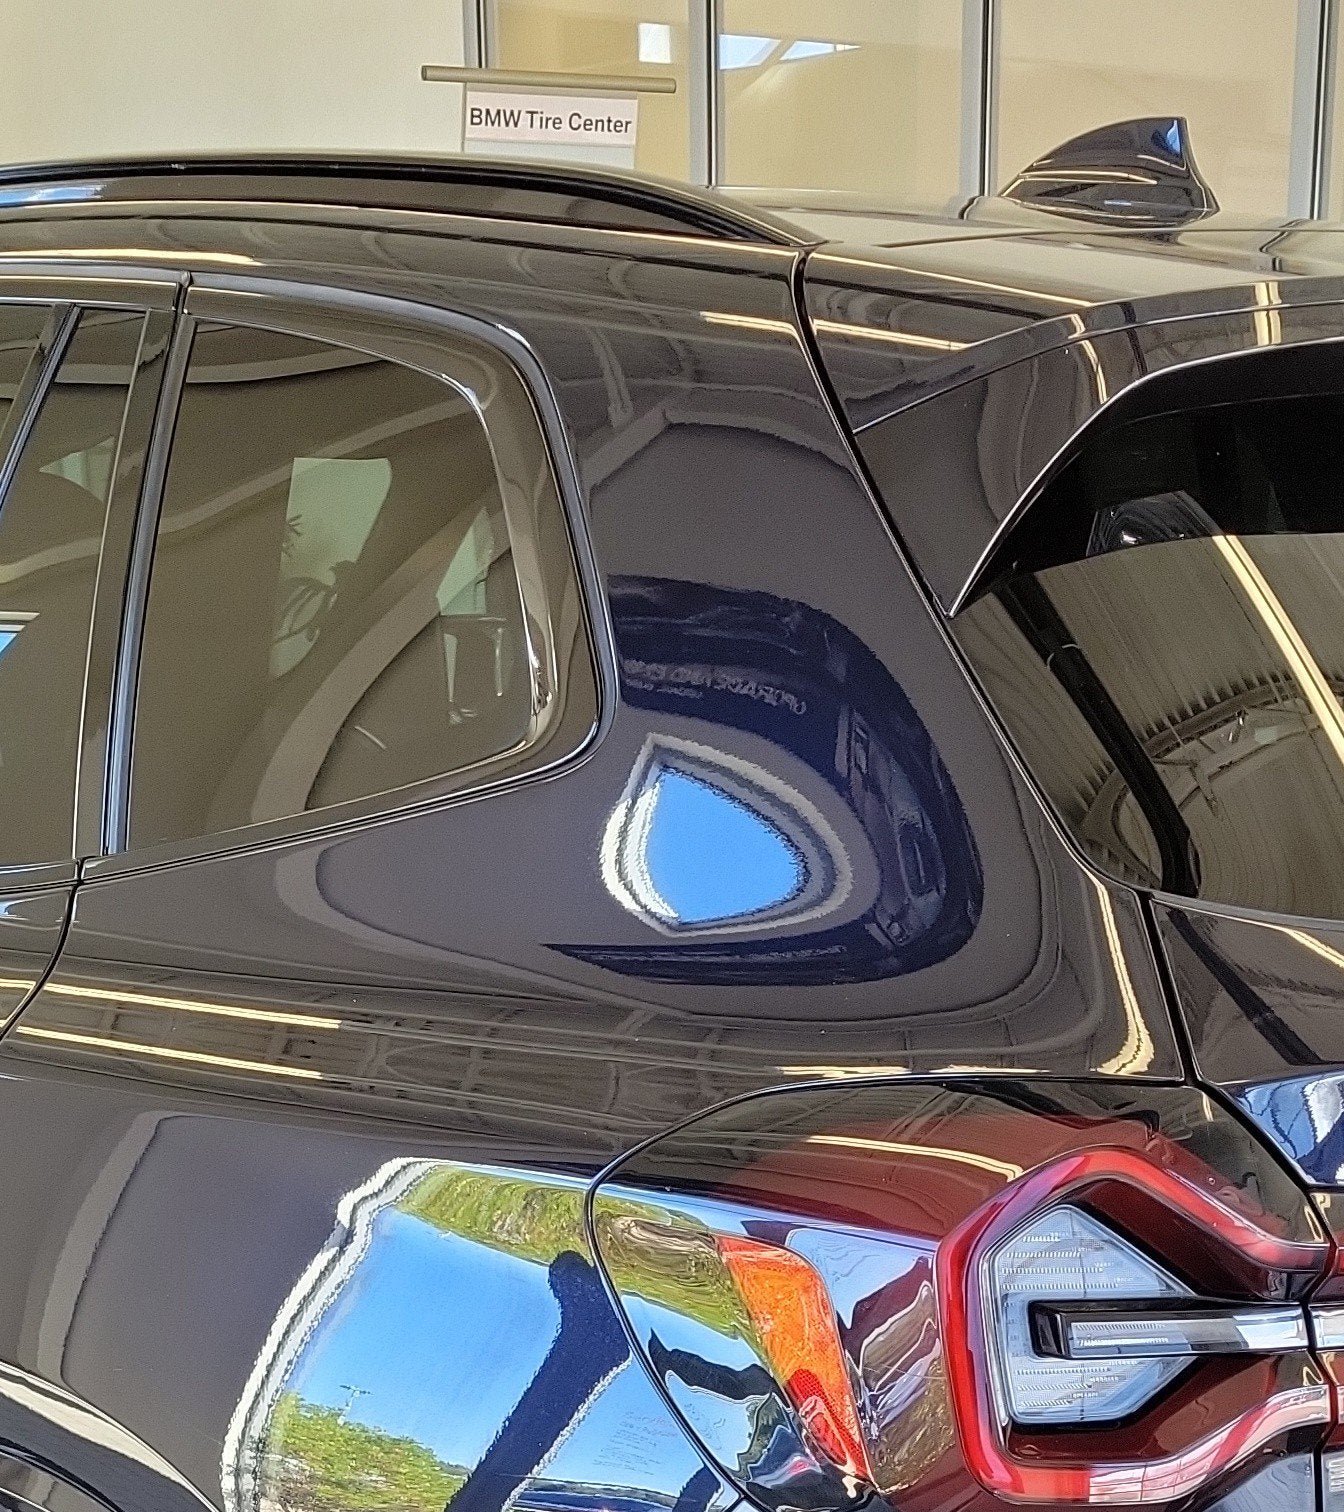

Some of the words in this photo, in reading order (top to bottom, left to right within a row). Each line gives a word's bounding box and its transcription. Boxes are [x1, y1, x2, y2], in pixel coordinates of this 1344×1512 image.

[469, 107, 523, 129] BMW
[525, 110, 563, 131] Tire
[568, 112, 633, 134] Center
